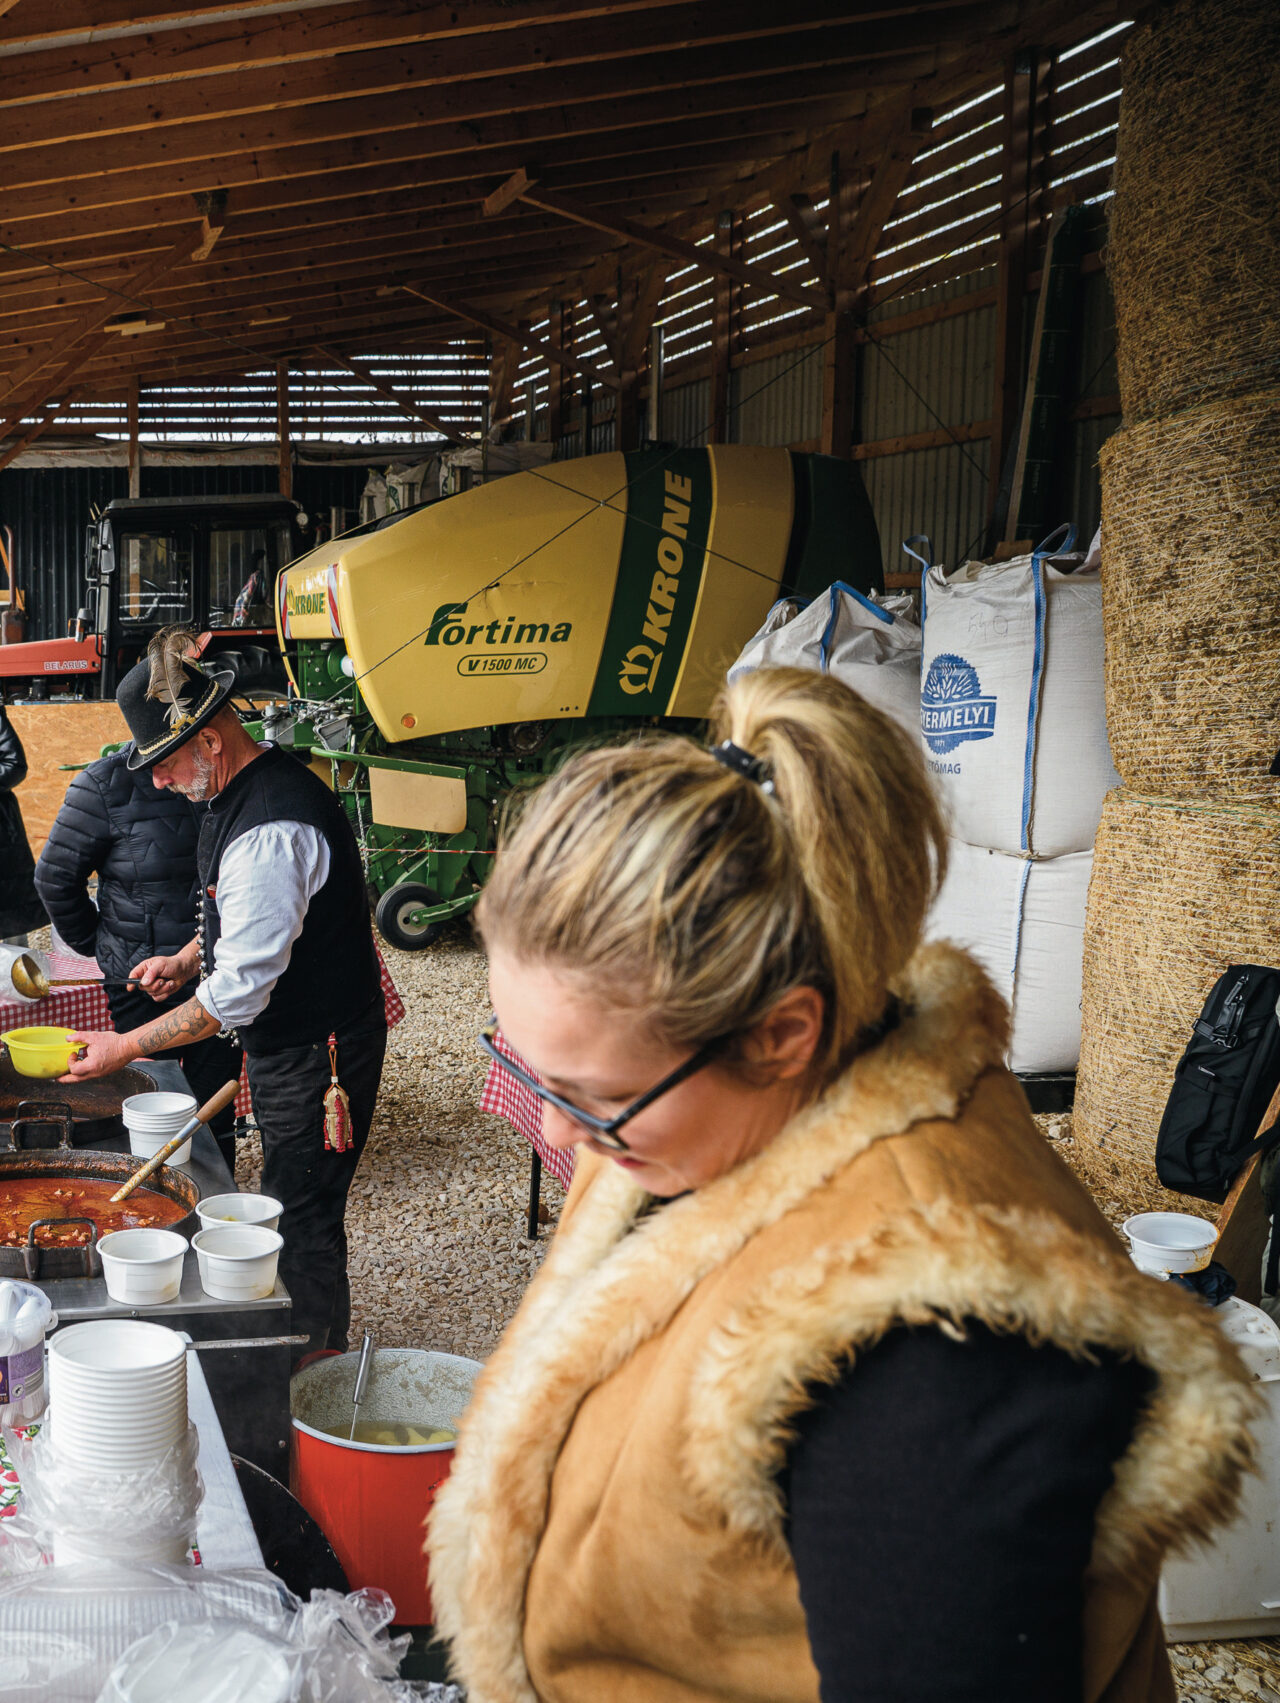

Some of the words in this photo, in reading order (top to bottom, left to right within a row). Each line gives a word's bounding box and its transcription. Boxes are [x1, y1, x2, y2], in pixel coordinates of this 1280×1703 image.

[642, 469, 692, 646] KRONE
[295, 592, 326, 616] KRONE
[424, 602, 573, 646] Fortima
[43, 660, 89, 670] BELARUS
[468, 659, 481, 672] V
[482, 658, 513, 672] 1500
[514, 657, 538, 671] MC
